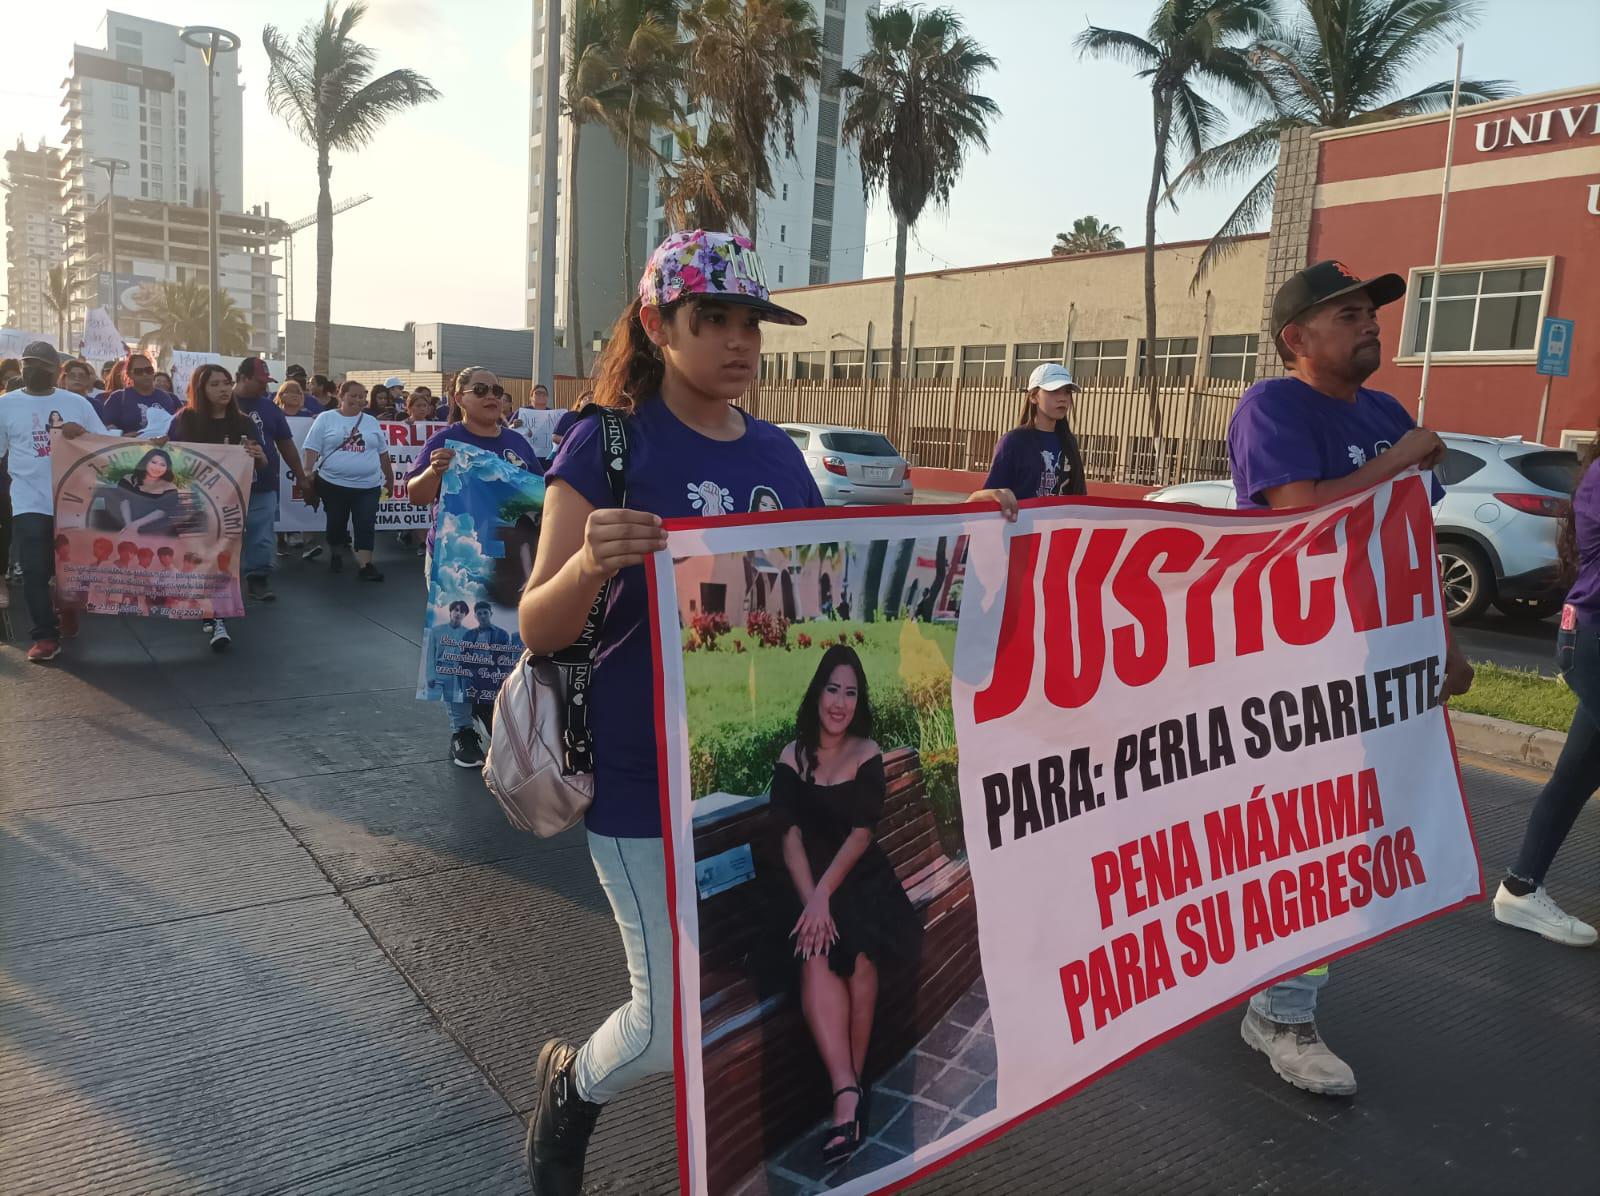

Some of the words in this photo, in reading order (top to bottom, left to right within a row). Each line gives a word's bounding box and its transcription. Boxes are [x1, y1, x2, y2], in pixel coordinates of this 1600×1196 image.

[403, 515, 426, 525] QUE
[973, 474, 1435, 724] JUSTICIA
[982, 746, 1105, 850] PARA:
[1114, 706, 1236, 801] PERLA
[1241, 655, 1441, 759] SCARLETTE
[1091, 820, 1203, 930] PENA
[1203, 767, 1385, 881] MÁXIMA
[1059, 918, 1178, 1045] PARA
[1175, 890, 1236, 978] SU
[1243, 825, 1427, 952] AGRESOR
